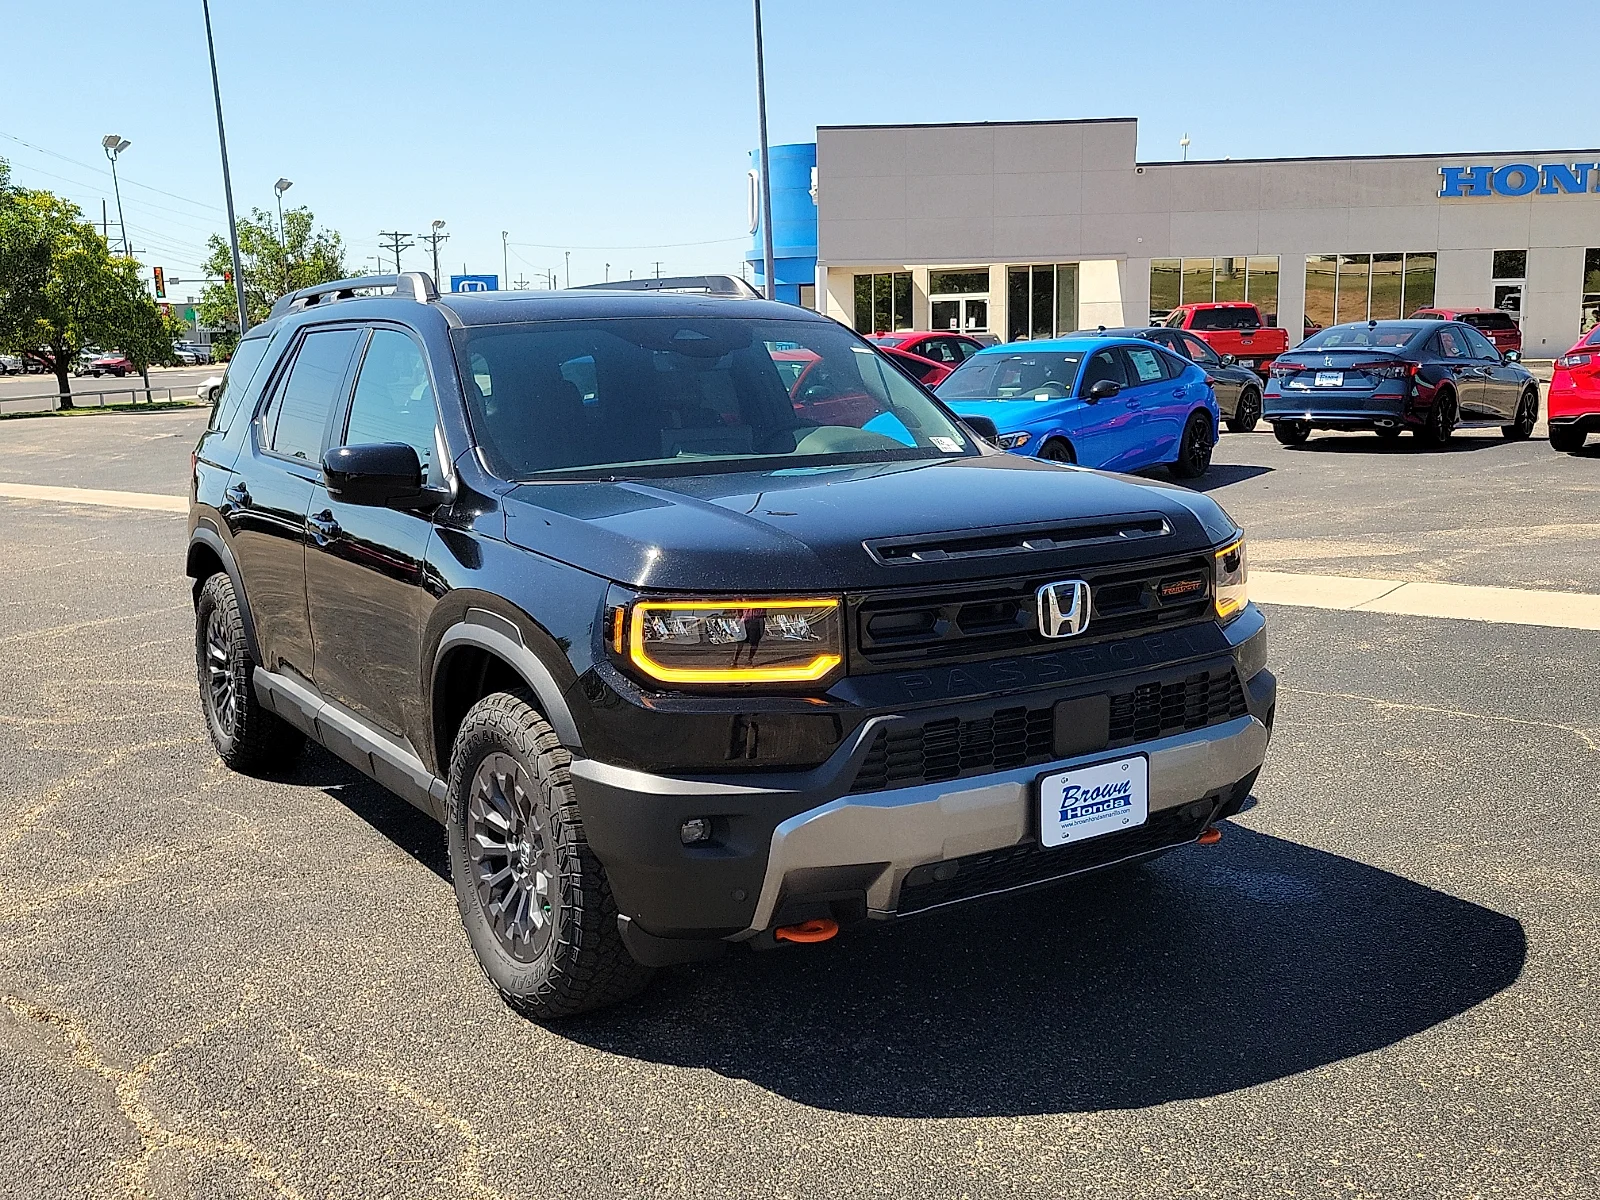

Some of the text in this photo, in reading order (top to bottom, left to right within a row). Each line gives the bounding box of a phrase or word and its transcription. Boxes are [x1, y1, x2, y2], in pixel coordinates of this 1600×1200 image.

[1438, 163, 1600, 197] HON
[895, 633, 1201, 698] PASSPORT
[1060, 779, 1132, 809] Brown
[1067, 799, 1125, 819] Honda
